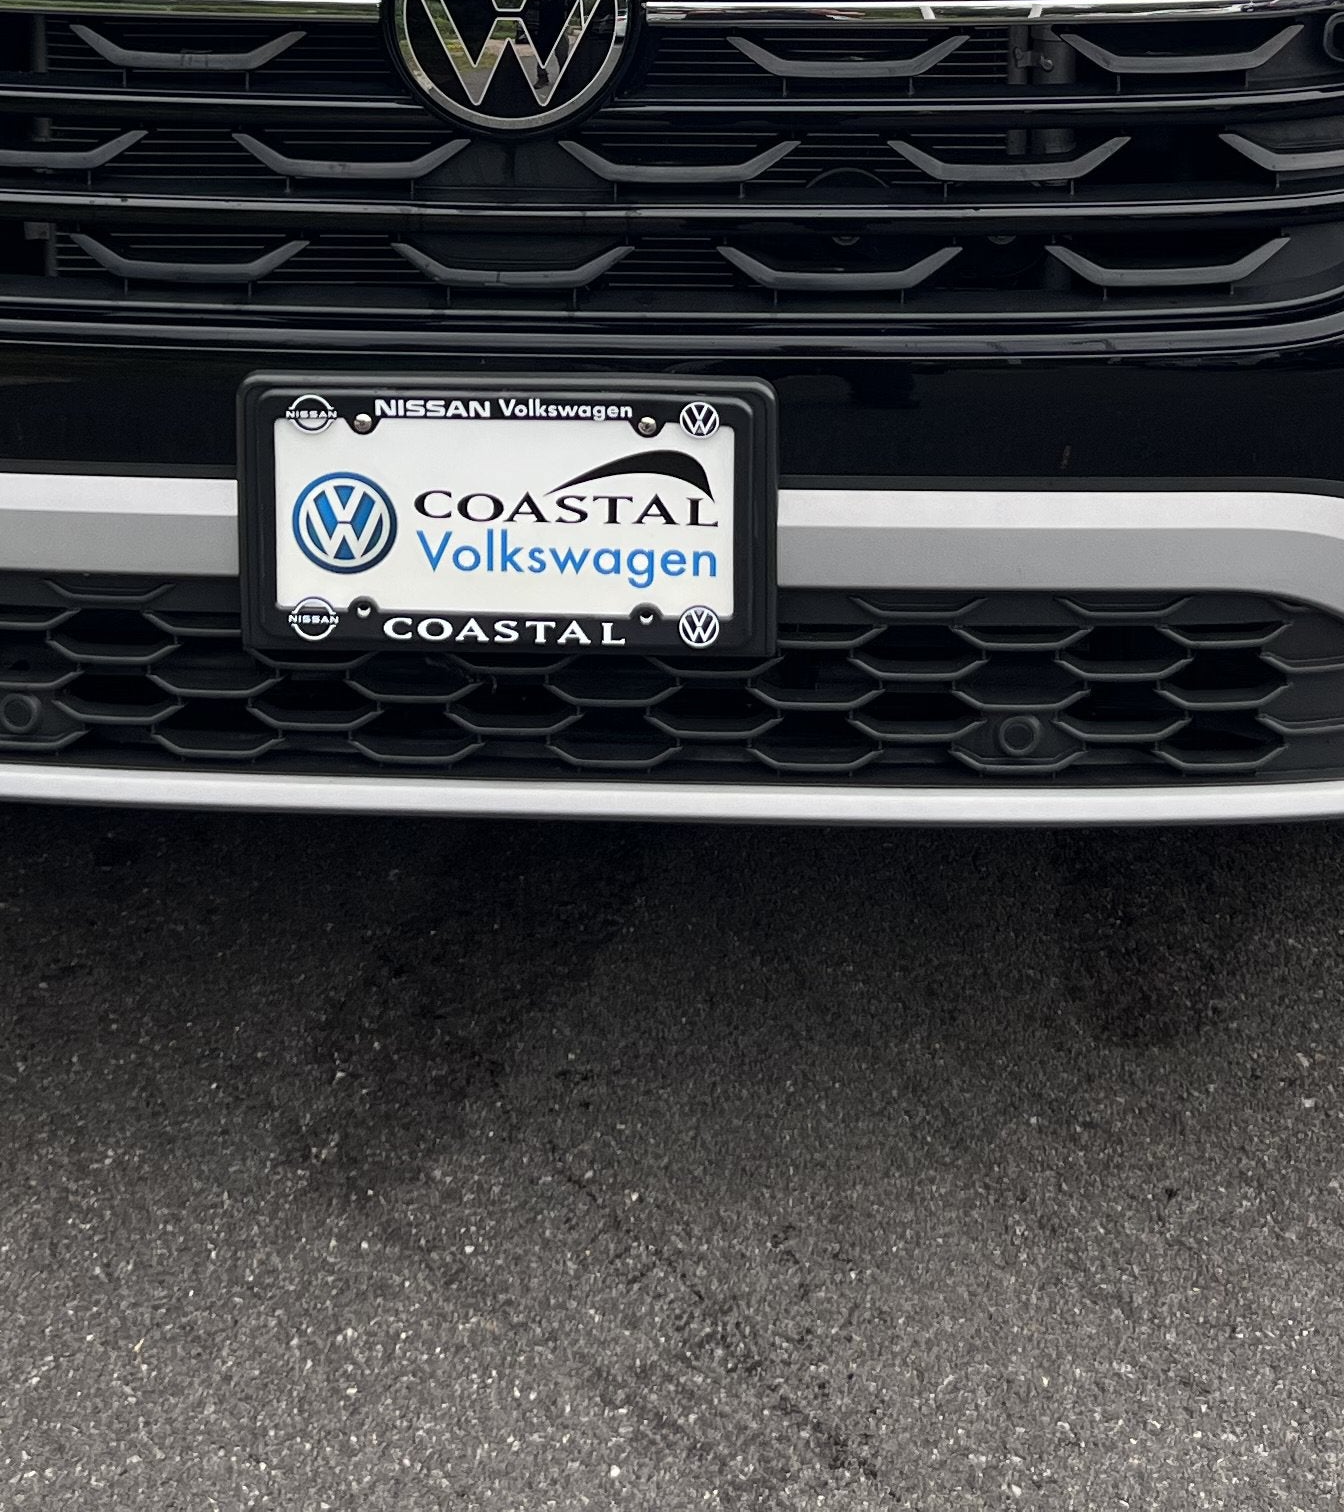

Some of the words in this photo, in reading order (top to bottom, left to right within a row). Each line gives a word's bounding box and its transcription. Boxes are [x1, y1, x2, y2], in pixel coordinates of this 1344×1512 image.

[286, 410, 338, 419] NISSAN
[374, 398, 491, 419] NISSAN
[497, 399, 633, 420] Volkswagen
[681, 403, 718, 437] VW
[299, 479, 391, 567] VW
[413, 490, 719, 528] COASTAL
[416, 529, 718, 588] Volkswagen
[288, 614, 340, 626] NISSAN
[383, 616, 626, 647] COASTAL
[681, 607, 718, 647] VW
